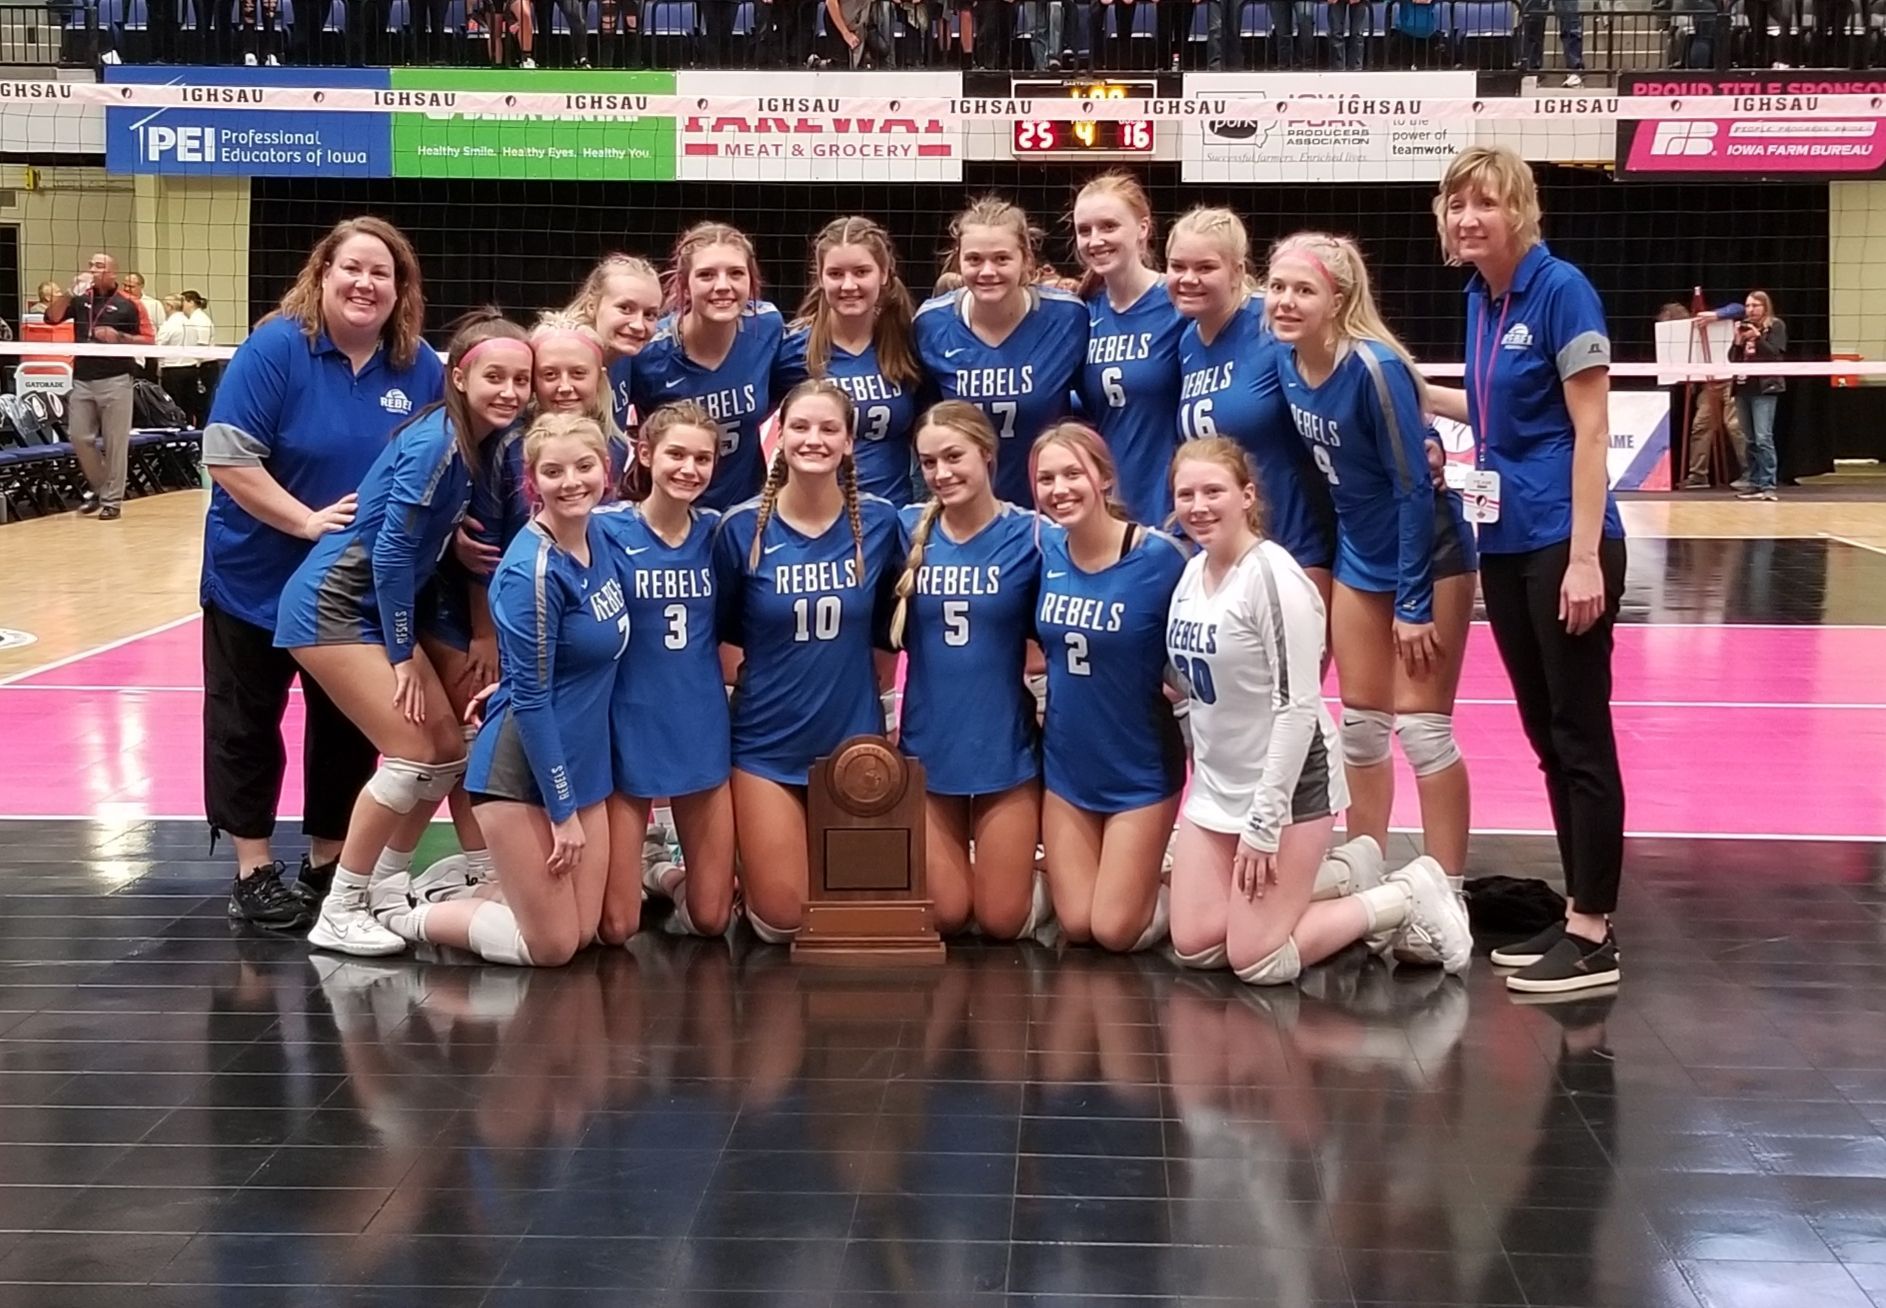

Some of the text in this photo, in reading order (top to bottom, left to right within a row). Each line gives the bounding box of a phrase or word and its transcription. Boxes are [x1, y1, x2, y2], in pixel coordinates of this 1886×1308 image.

[182, 88, 264, 104] IGHSAU
[374, 91, 456, 107] IGHSAU
[565, 95, 648, 110] IGHSAU
[1787, 82, 1886, 94] SPONSO
[757, 98, 840, 113] IGHSAU
[950, 99, 1033, 115] IGHSAU
[1143, 99, 1226, 115] IGHSAU
[1337, 100, 1422, 115] IGHSAU
[1534, 99, 1619, 113] IGHSAU
[1733, 97, 1819, 112] IGHSAU
[148, 126, 216, 162] PEI
[221, 129, 322, 148] Professional
[1018, 121, 1053, 149] 25
[1075, 120, 1094, 147] 4
[1123, 120, 1150, 149] 16
[1392, 129, 1447, 142] power of
[221, 148, 367, 166] Educators of Iowa
[417, 145, 652, 160] Healthy Smile. Healthy Eyes. Healthy You.
[725, 144, 912, 157] MEAT & GROCERY
[1392, 144, 1459, 155] teamwork.
[1727, 144, 1873, 156] IOWA FARM BUREAU
[1086, 333, 1152, 365] REBELS
[956, 365, 1033, 397] REBELS
[1101, 366, 1127, 407] 6
[682, 384, 756, 420] BELS
[853, 405, 891, 440] 13
[973, 401, 1017, 438] 7
[1181, 398, 1218, 441] 16
[635, 568, 712, 598] REBELS
[776, 558, 857, 594] REBELS
[917, 566, 1000, 595] REBELS
[794, 596, 841, 641] 10
[943, 601, 969, 646] 5
[1040, 592, 1125, 632] REBELS
[613, 612, 631, 660] 7
[664, 604, 688, 650] 3
[1168, 618, 1217, 655] REBELS
[1064, 632, 1091, 675] 2
[551, 765, 570, 800] REBELS
